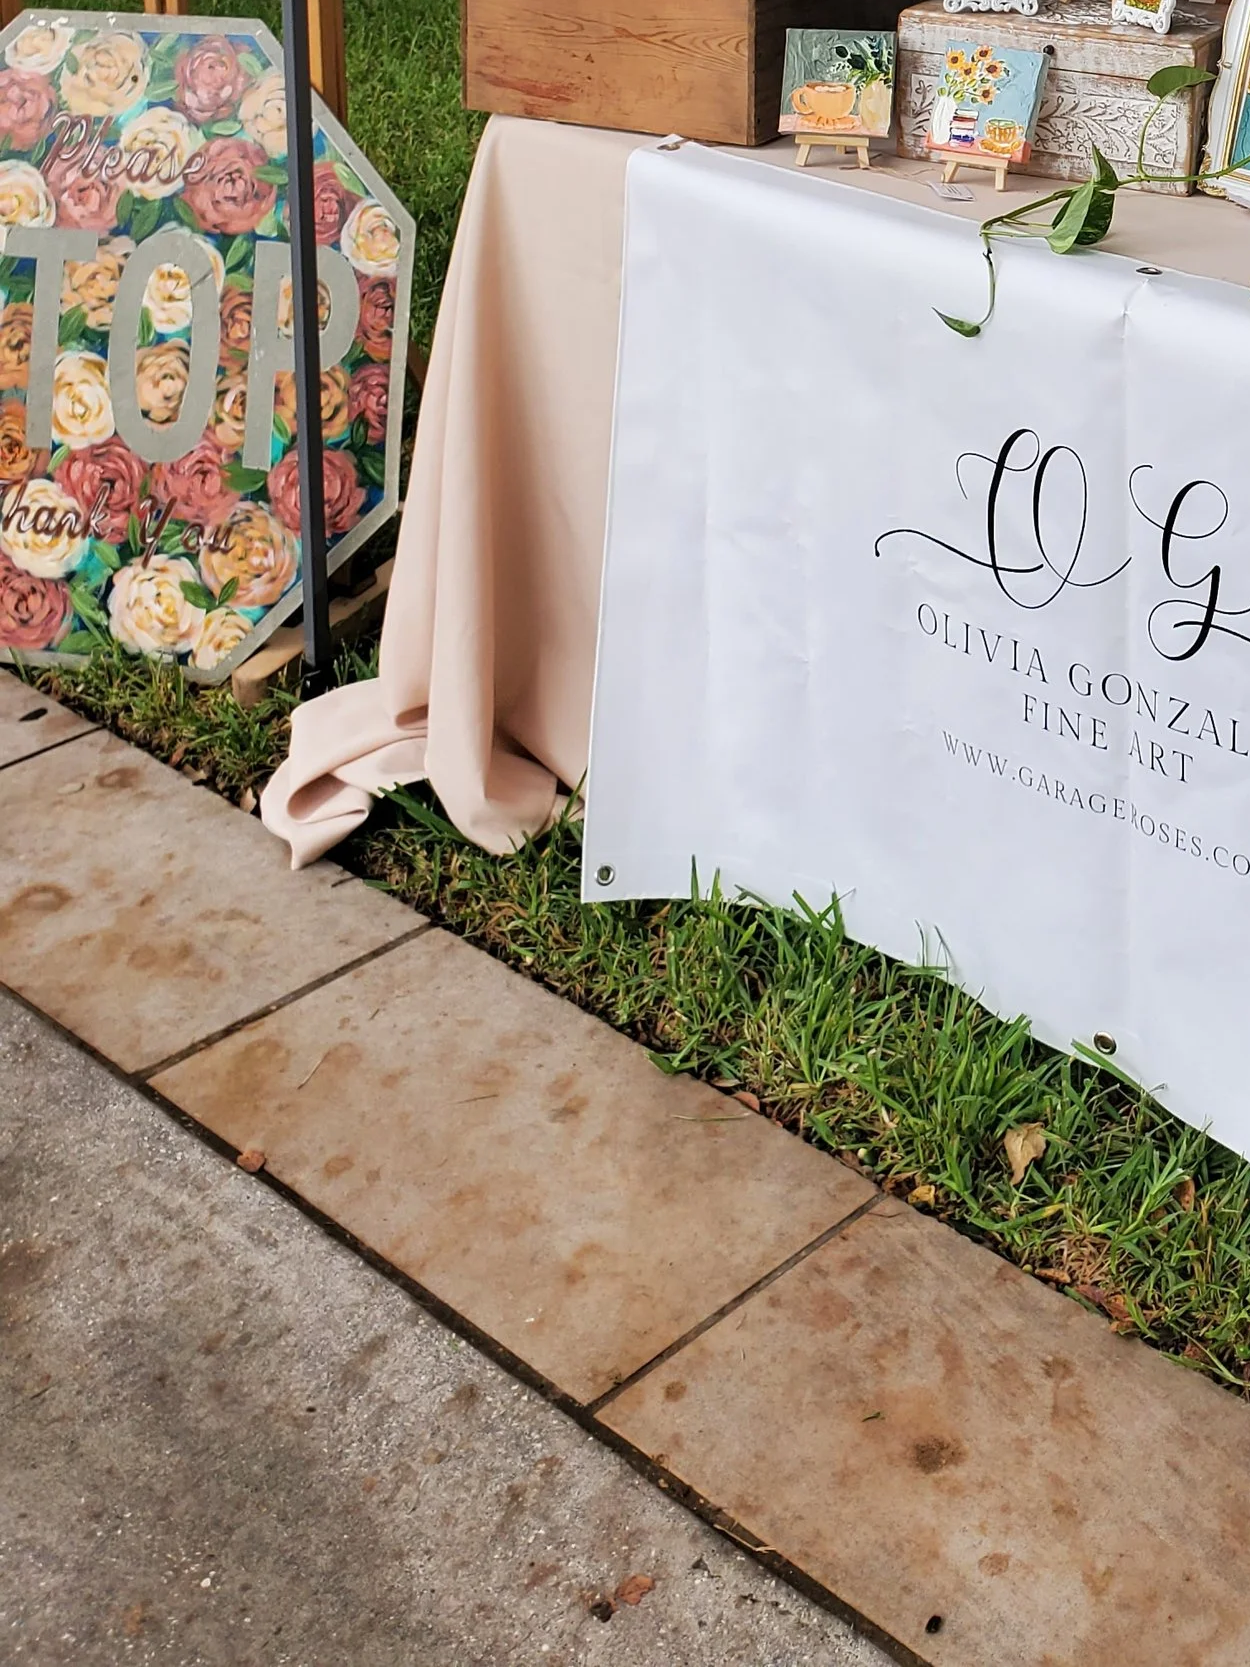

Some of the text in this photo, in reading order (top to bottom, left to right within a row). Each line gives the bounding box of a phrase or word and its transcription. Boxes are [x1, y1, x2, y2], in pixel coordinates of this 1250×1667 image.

[39, 111, 210, 185] Please
[0, 475, 237, 569] hank You
[917, 603, 1048, 684] OLIVIA
[1021, 693, 1195, 783] FINE ART
